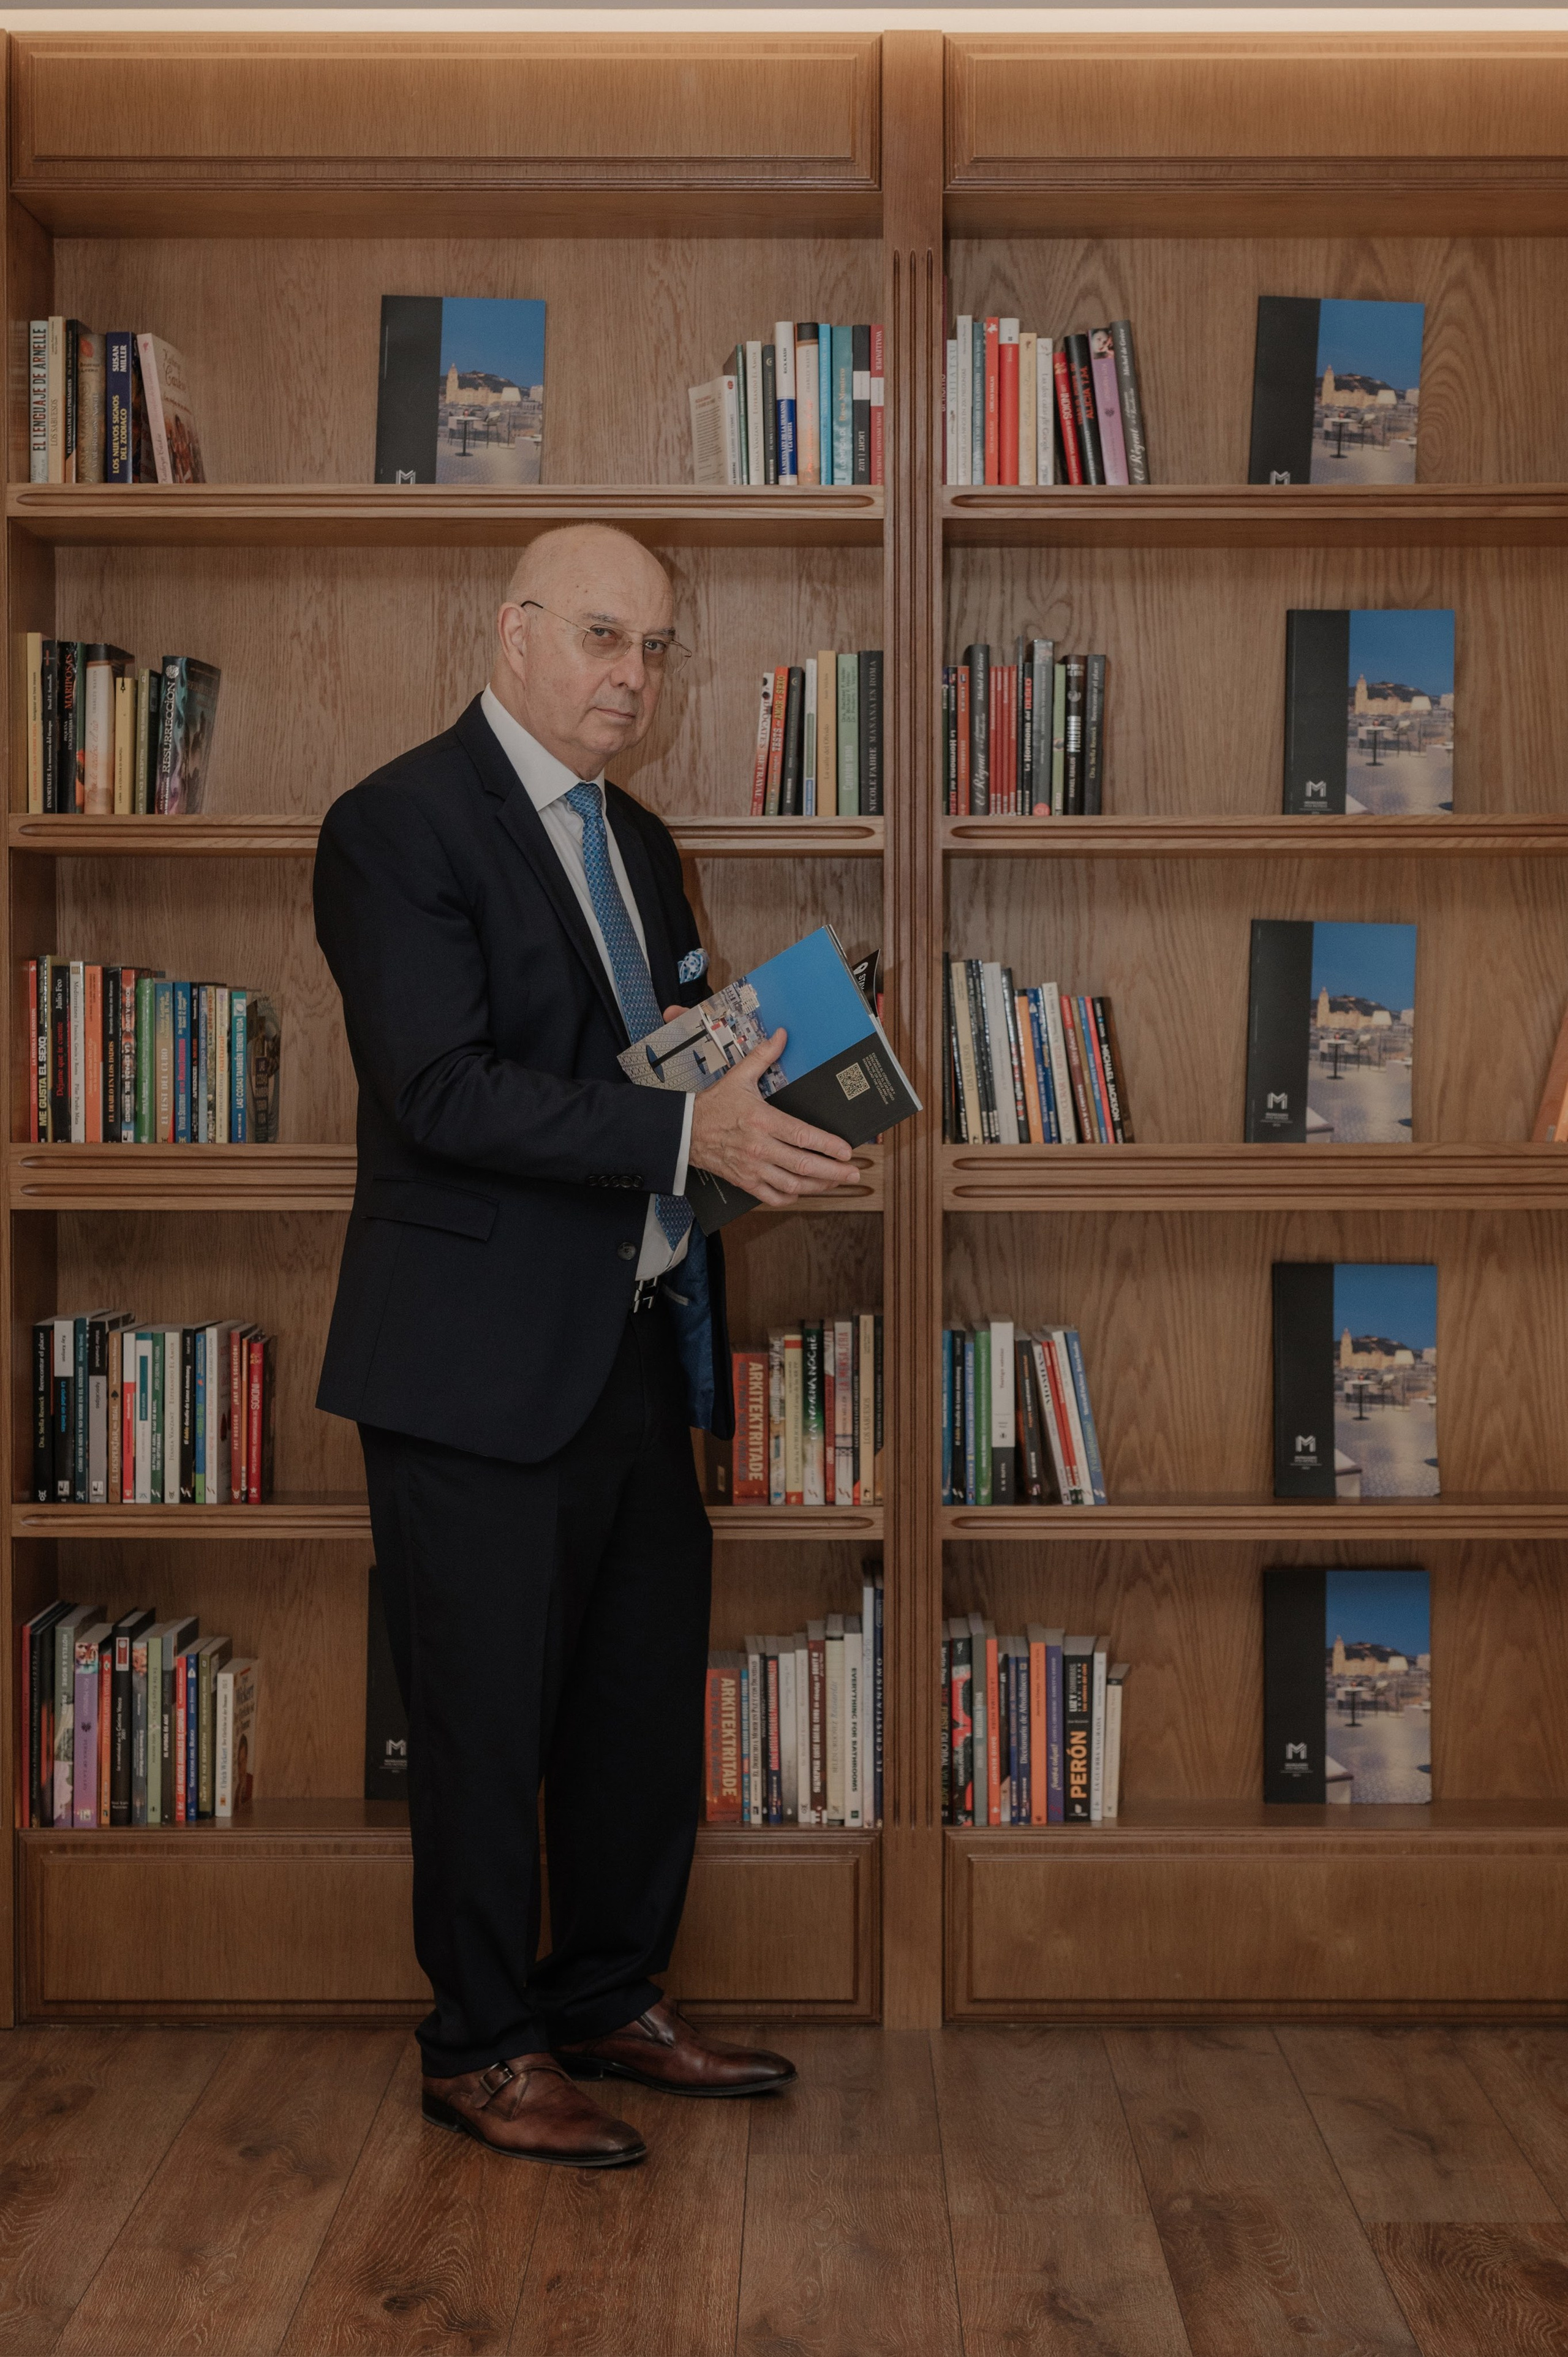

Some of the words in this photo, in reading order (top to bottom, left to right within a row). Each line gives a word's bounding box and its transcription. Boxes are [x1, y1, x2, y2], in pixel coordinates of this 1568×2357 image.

[32, 329, 47, 369] ARNELLE
[32, 374, 47, 384] DE
[32, 388, 47, 437] LENGUAJE
[1060, 393, 1071, 420] INDIOS
[32, 442, 47, 451] EL
[776, 675, 785, 695] SEXO
[775, 701, 784, 719] AMOR
[772, 728, 782, 752] TESTS
[755, 755, 765, 797] BETRAYAL
[39, 1064, 47, 1075] EL
[235, 1053, 243, 1077] TAMBIÉN
[1101, 1044, 1114, 1082] MICHAEL
[108, 1079, 114, 1087] EN
[1107, 1083, 1120, 1121] JACKSON
[39, 1111, 47, 1126] ME
[161, 1115, 168, 1124] EL
[808, 1335, 818, 1375] NOCHE
[251, 1383, 260, 1409] INDIOS
[748, 1362, 763, 1480] ARKITEKTRITADE
[1295, 1435, 1315, 1452] M
[1019, 1716, 1027, 1724] de
[722, 1678, 737, 1796] ARKITEKTRITADE
[1286, 1742, 1306, 1759] M
[876, 1760, 883, 1771] EL
[1066, 1731, 1087, 1798] PERÓN
